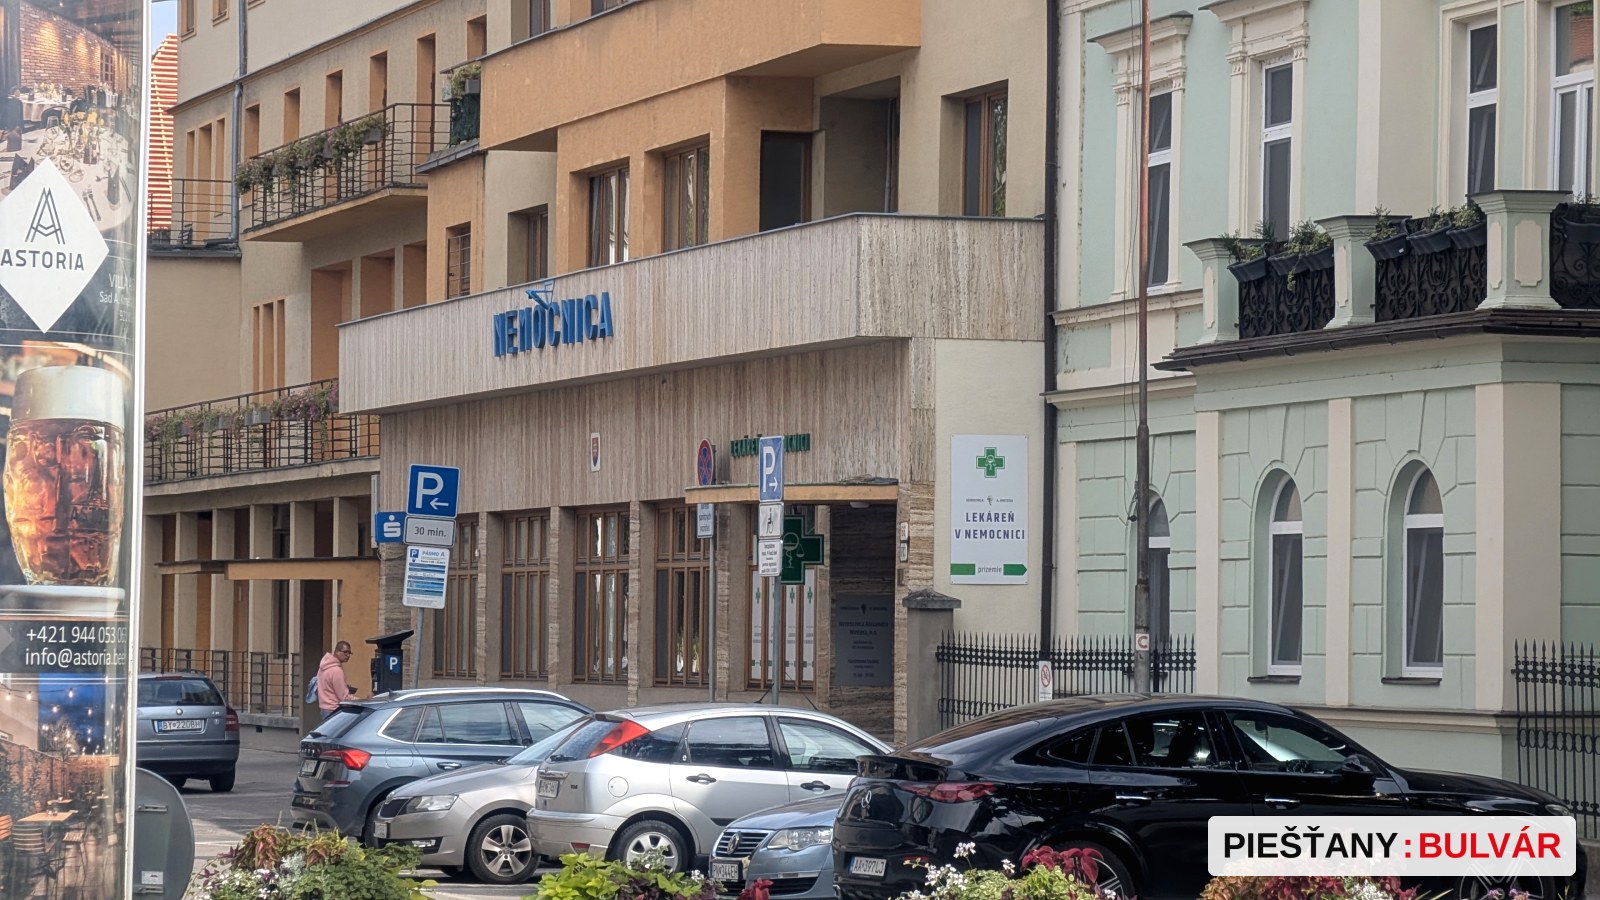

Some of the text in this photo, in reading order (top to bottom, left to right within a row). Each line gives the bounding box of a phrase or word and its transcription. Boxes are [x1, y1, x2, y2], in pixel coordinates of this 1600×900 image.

[0, 248, 85, 271] ASTORIA
[493, 291, 614, 358] NEMOCNICA
[763, 446, 776, 493] P
[415, 471, 444, 509] P
[965, 510, 1015, 523] LEKÁREŇ
[414, 526, 447, 537] 30 min.
[954, 529, 1025, 540] V NEMOCNICI
[26, 626, 66, 643] +421
[71, 626, 96, 643] 944
[98, 627, 116, 643] 053
[389, 656, 398, 670] P
